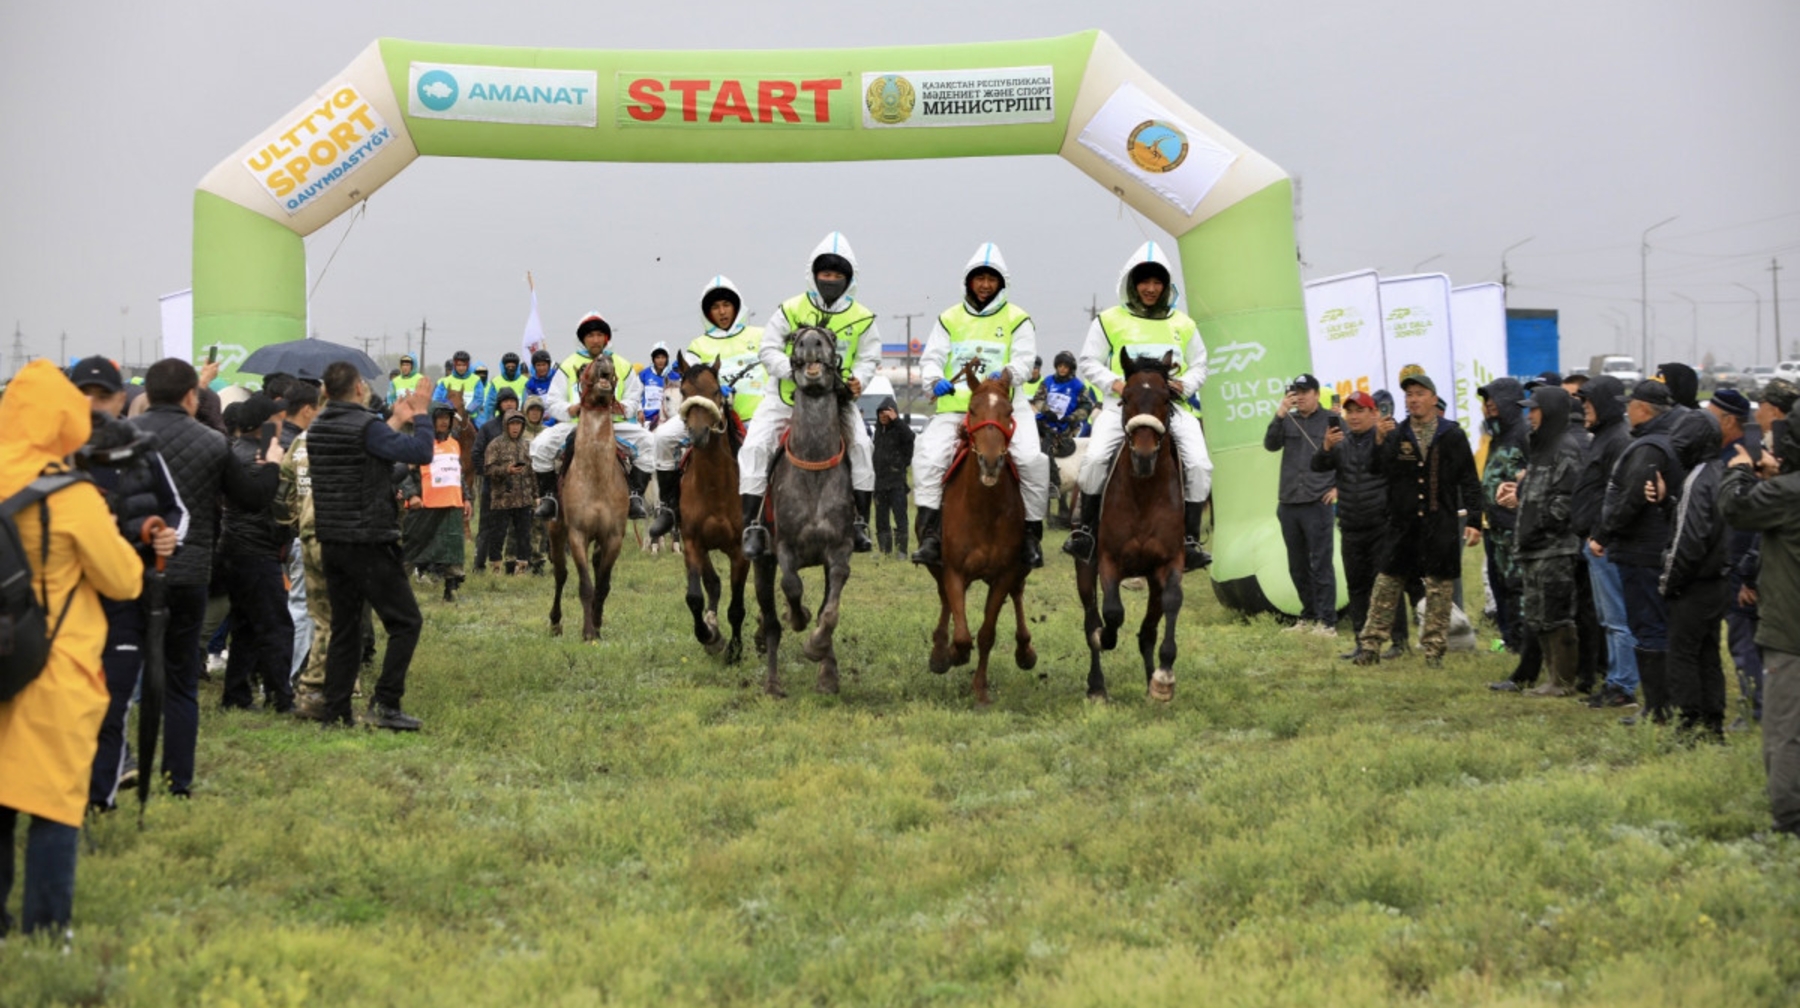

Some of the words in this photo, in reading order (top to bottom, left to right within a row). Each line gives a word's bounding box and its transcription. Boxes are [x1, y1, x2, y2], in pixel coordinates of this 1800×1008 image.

[468, 83, 588, 105] AMANAT
[922, 81, 974, 90] ҚАЗАҚСТАН
[977, 77, 1051, 87] РЕСПУБЛИКАСЫ
[922, 90, 981, 100] МӘДЕНИЕТ
[983, 88, 1014, 98] ЖӘНЕ
[1016, 86, 1051, 96] СПОРТ
[626, 78, 842, 123] START
[923, 96, 1052, 115] МИНИСТРЛІГІ
[247, 88, 359, 172] ULTTYQ
[266, 103, 376, 198] SPORT
[287, 127, 390, 210] QAUYMDASTYĞY
